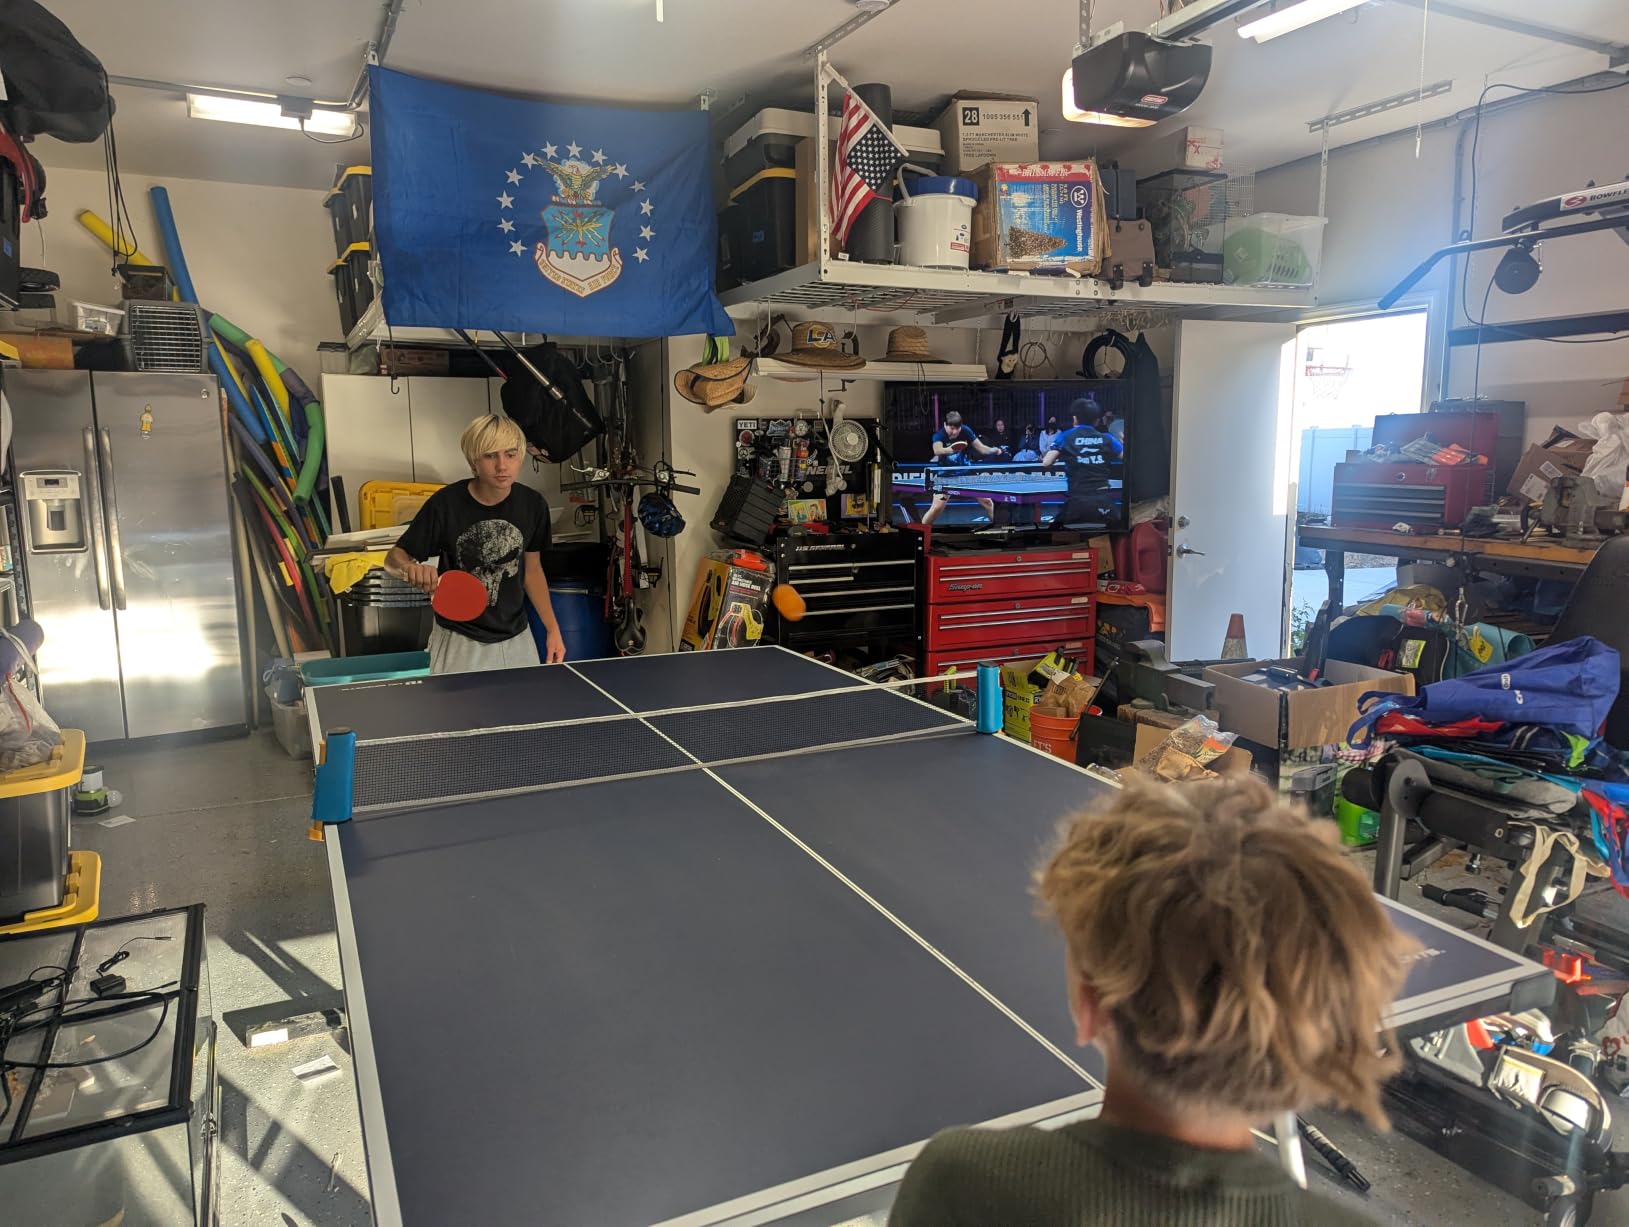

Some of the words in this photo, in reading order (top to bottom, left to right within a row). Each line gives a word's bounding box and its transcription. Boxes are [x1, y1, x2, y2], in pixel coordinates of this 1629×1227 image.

[964, 110, 978, 123] 28
[807, 328, 836, 344] LA
[1075, 437, 1103, 446] CHINA
[948, 583, 984, 592] Snap-on
